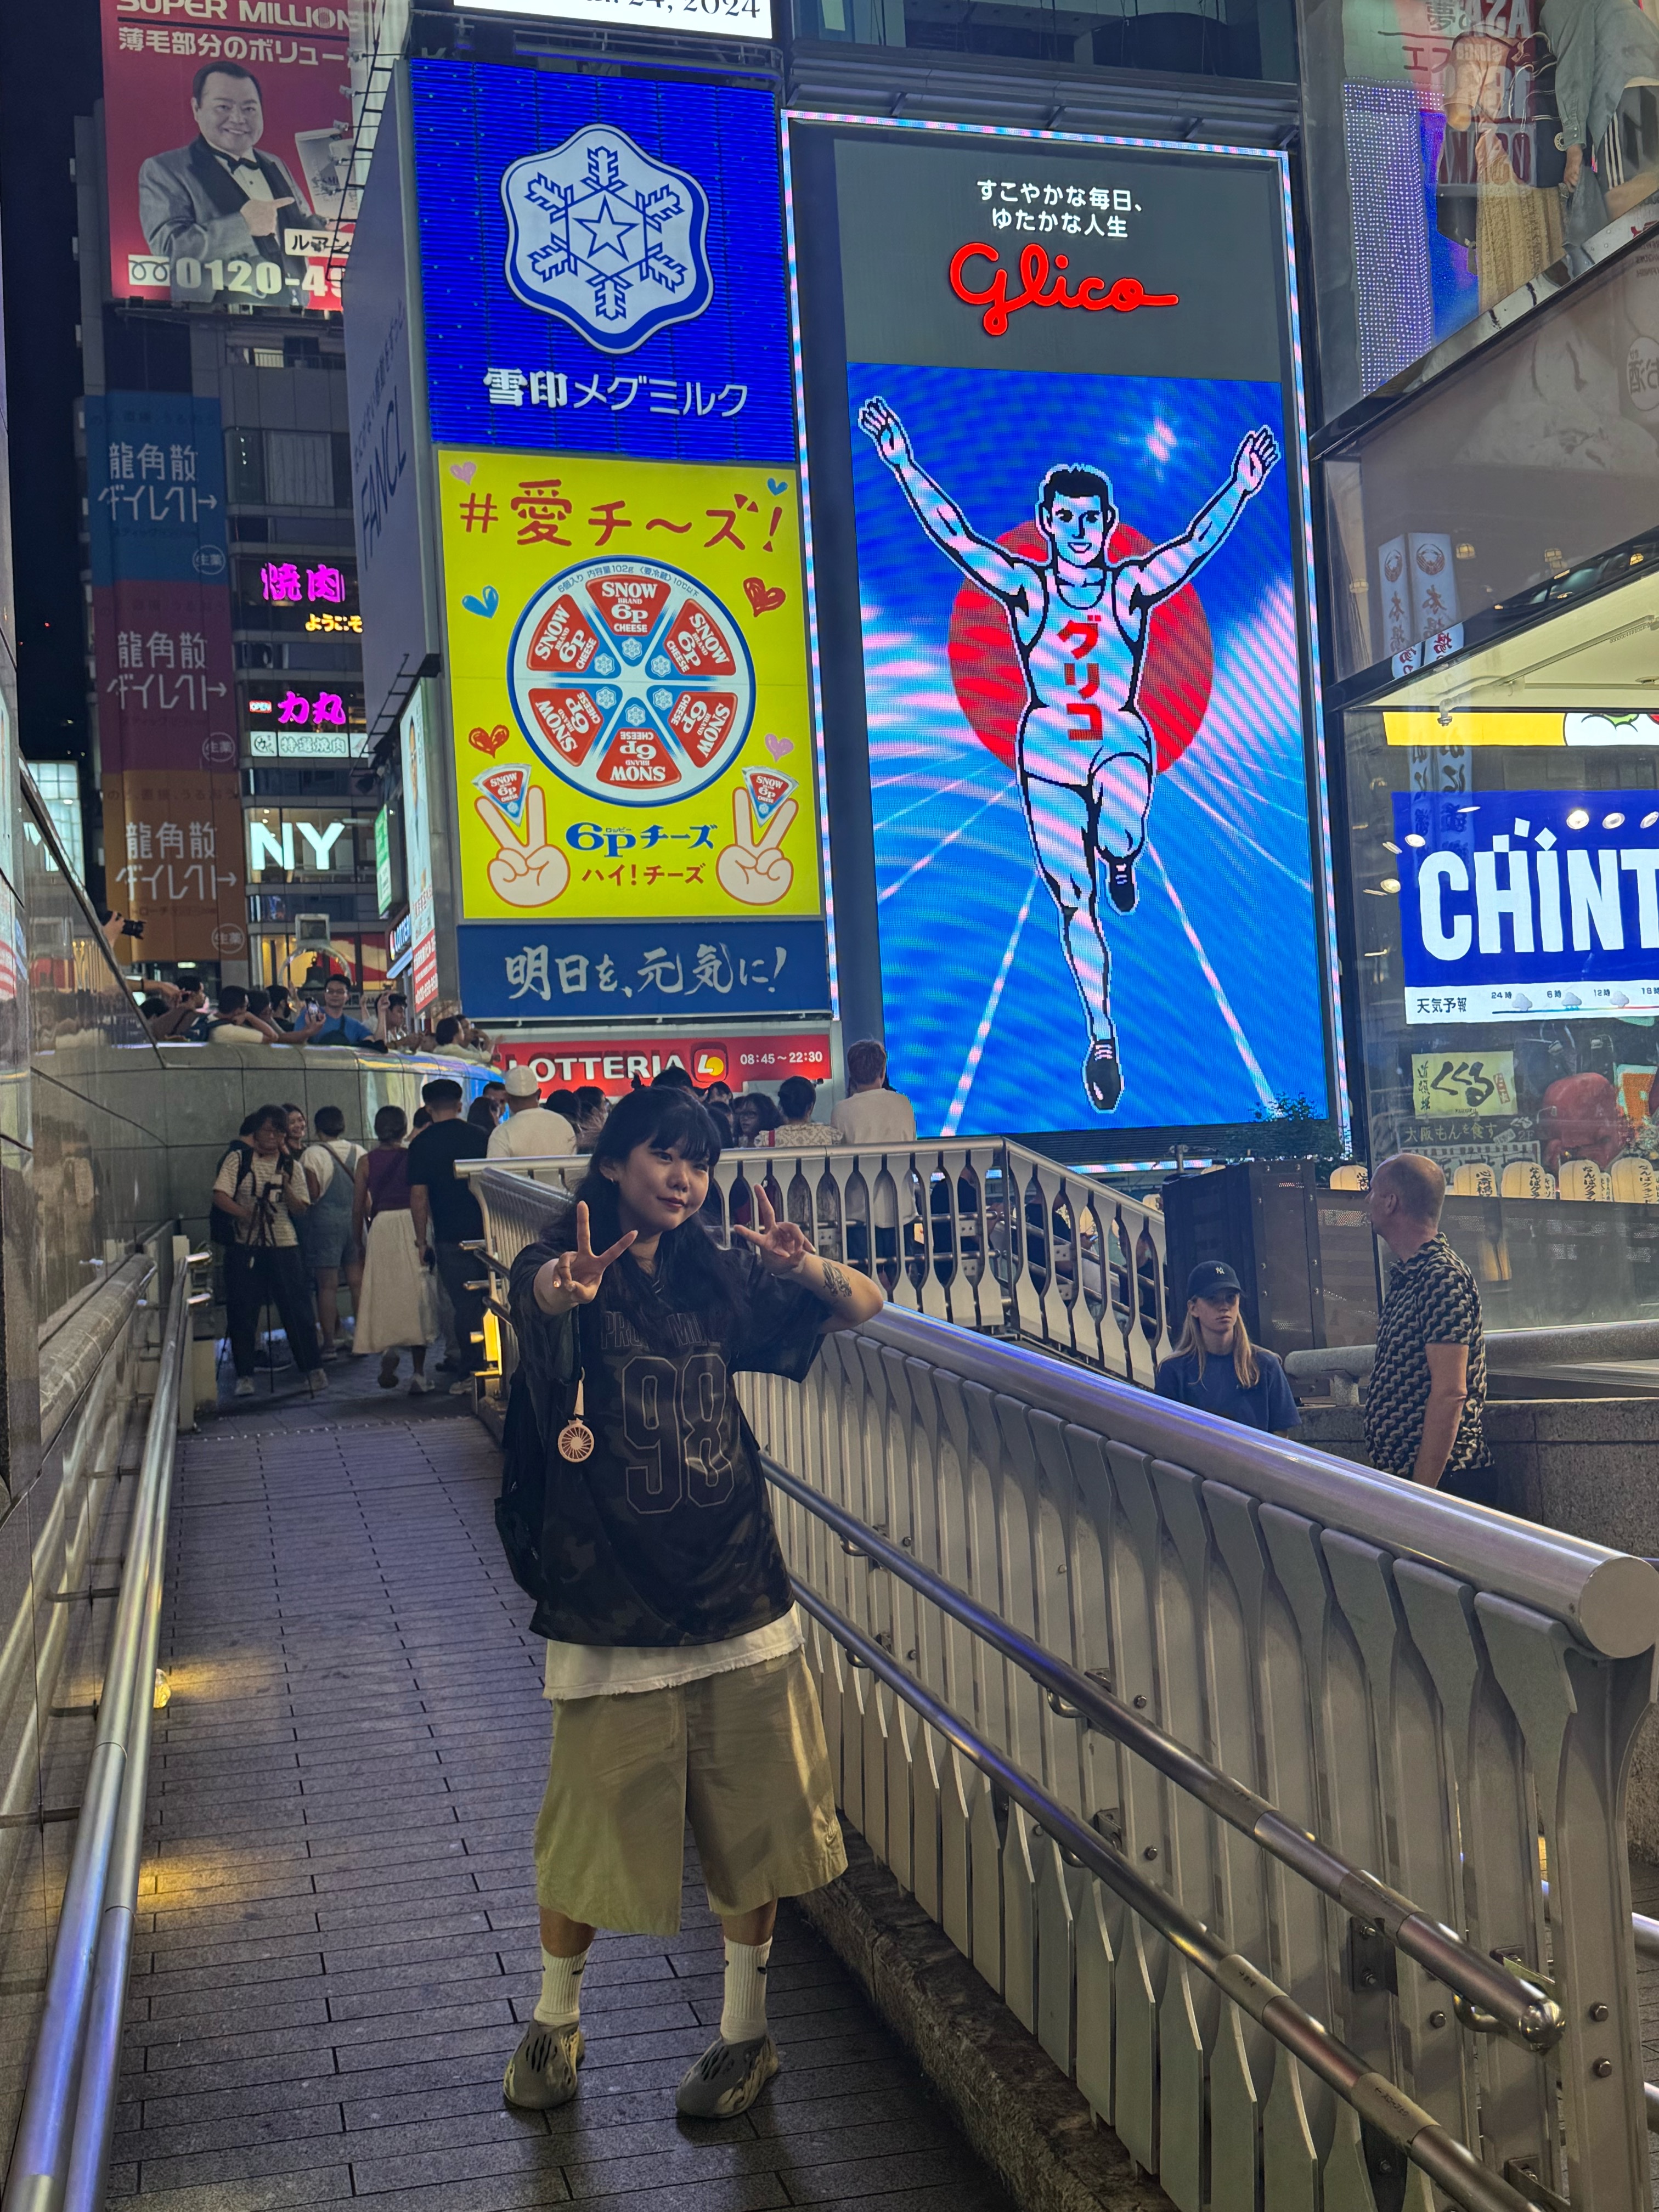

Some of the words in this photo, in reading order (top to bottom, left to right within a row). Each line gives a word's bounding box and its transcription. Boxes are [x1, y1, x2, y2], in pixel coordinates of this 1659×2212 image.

[119, 26, 345, 65] 薄毛部分のボリュー
[977, 179, 1143, 211] すこやかな毎日、
[992, 208, 1128, 238] ゆたかな人生
[949, 242, 1180, 336] Glico
[483, 367, 748, 417] 雪印メグミルク
[109, 441, 199, 481] 龍角散
[360, 385, 407, 571] FANCL
[98, 484, 218, 523] ダイレクト
[260, 562, 346, 602] 焼肉
[602, 582, 658, 599] SNOW
[305, 613, 363, 633] ようこそ
[535, 604, 570, 661] SNOW
[614, 623, 647, 633] CHEESE
[689, 613, 730, 663] SNOW
[117, 630, 208, 669] 龍角散
[575, 637, 597, 669] CHEESE
[667, 640, 690, 673] CHEESE
[106, 673, 227, 711] ダイレクト
[1057, 615, 1103, 741] グリコ
[277, 691, 346, 725] 力丸
[577, 691, 601, 724] CHEESE
[670, 694, 691, 726] CHEESE
[280, 736, 346, 754] 特選焼肉
[535, 701, 578, 752] SNOW
[620, 731, 654, 740] CHEESE
[697, 702, 730, 758] SNOW
[610, 766, 665, 781] SNOW
[757, 775, 783, 788] SNOW
[126, 821, 218, 860] 龍角散
[115, 865, 237, 901] ダイレクト
[1417, 997, 1467, 1013] 天気予報
[1430, 1061, 1494, 1107] くくる
[1404, 1122, 1498, 1143] 大阪もんを食す
[622, 1353, 735, 1514] 98
